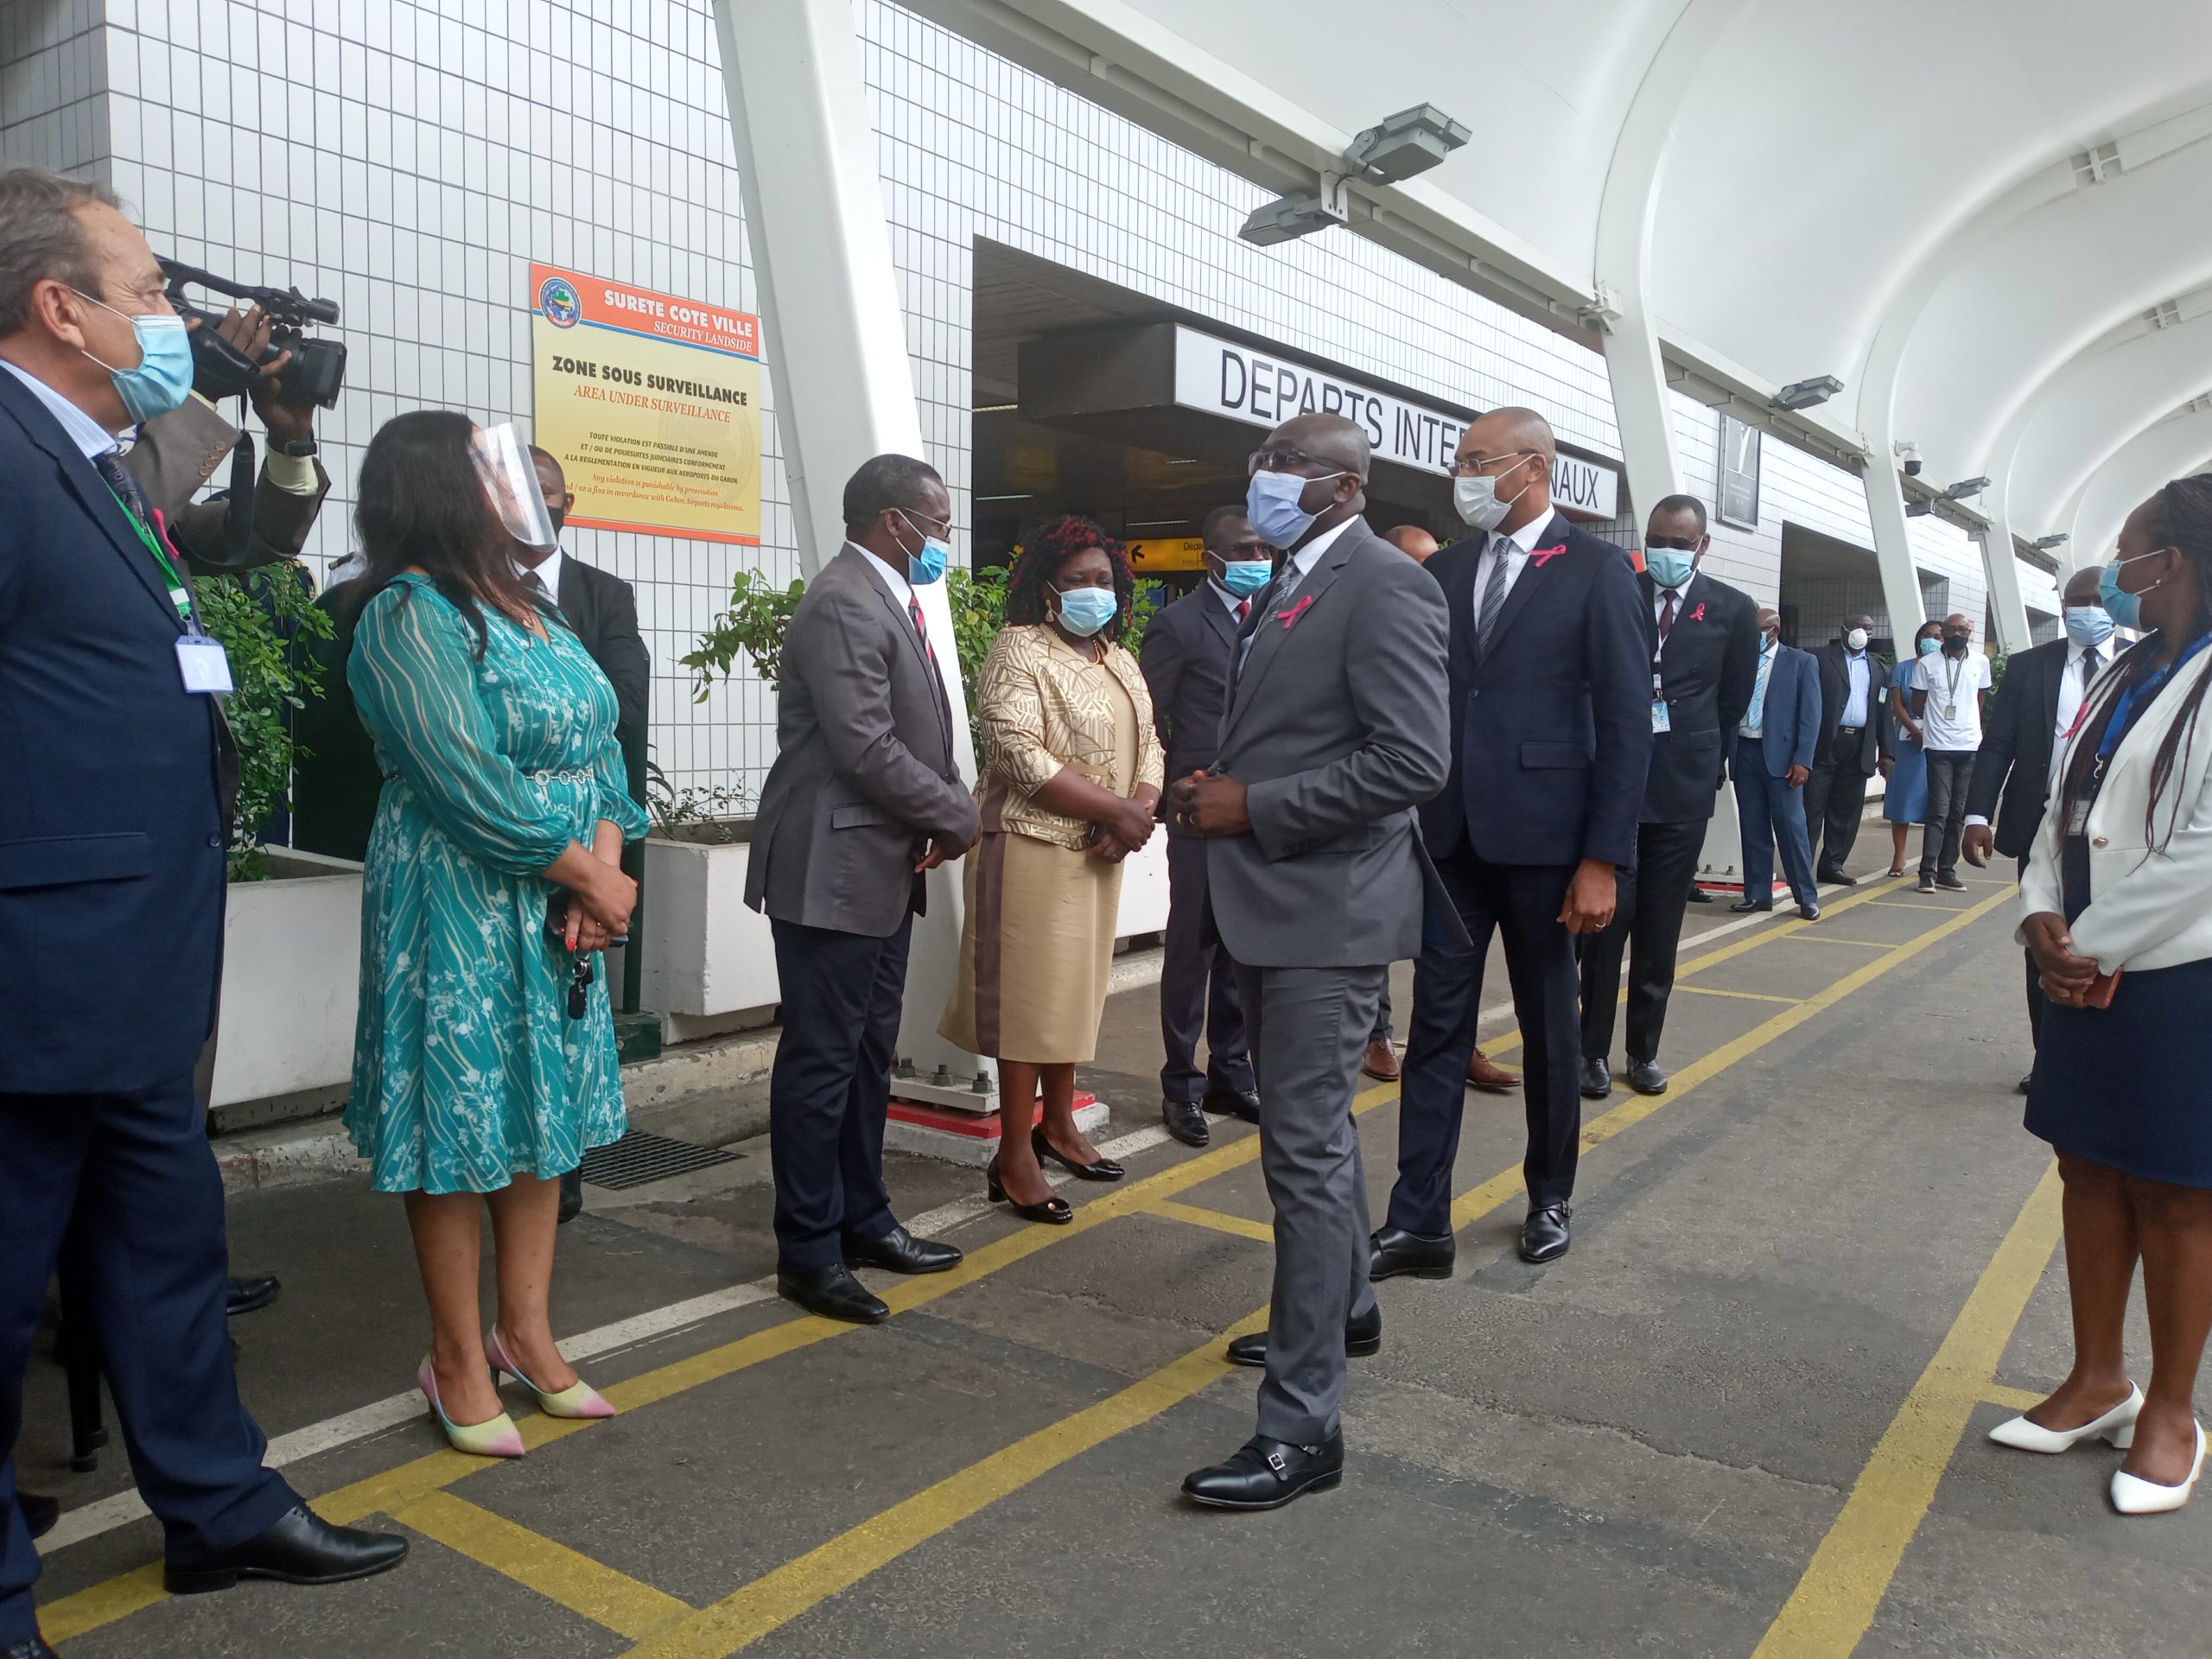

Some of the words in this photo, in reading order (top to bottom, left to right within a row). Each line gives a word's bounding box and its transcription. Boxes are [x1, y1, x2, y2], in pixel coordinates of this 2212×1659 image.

[604, 289, 664, 317] SURETE
[669, 305, 709, 327] COTE
[712, 315, 753, 337] VILLE
[654, 321, 704, 341] SECURITY
[705, 332, 753, 352] LANDSIDE
[552, 355, 597, 378] ZONE
[602, 365, 642, 386] SOUS
[647, 374, 747, 406] SURVEILLANCE
[574, 385, 606, 401] AREA
[609, 390, 648, 408] UNDER
[651, 398, 731, 423] SURVEILLANCE
[1221, 349, 1383, 449] DEPARTS
[589, 432, 609, 441] TOUTE
[610, 435, 640, 446] VIOLATION
[653, 442, 678, 451] PASSIBLE
[680, 446, 696, 454] D'UNE
[697, 449, 718, 458] AMENDE
[614, 448, 649, 459] POURSUITES
[650, 454, 683, 464] JUDICIAIRES
[683, 458, 726, 470] CONFORMEMENT
[579, 456, 631, 469] REGLEMENTATION
[641, 464, 665, 473] VIGUEUR
[679, 470, 710, 480] AEROPORTS
[592, 474, 605, 483] Any
[606, 475, 635, 486] violation
[642, 480, 675, 492] punishable
[676, 484, 684, 493] by
[685, 487, 718, 496] prosecution
[592, 485, 605, 495] fine
[614, 490, 649, 500] accordance
[651, 493, 665, 502] with
[666, 495, 685, 504] Gabon
[685, 498, 710, 508] Airports
